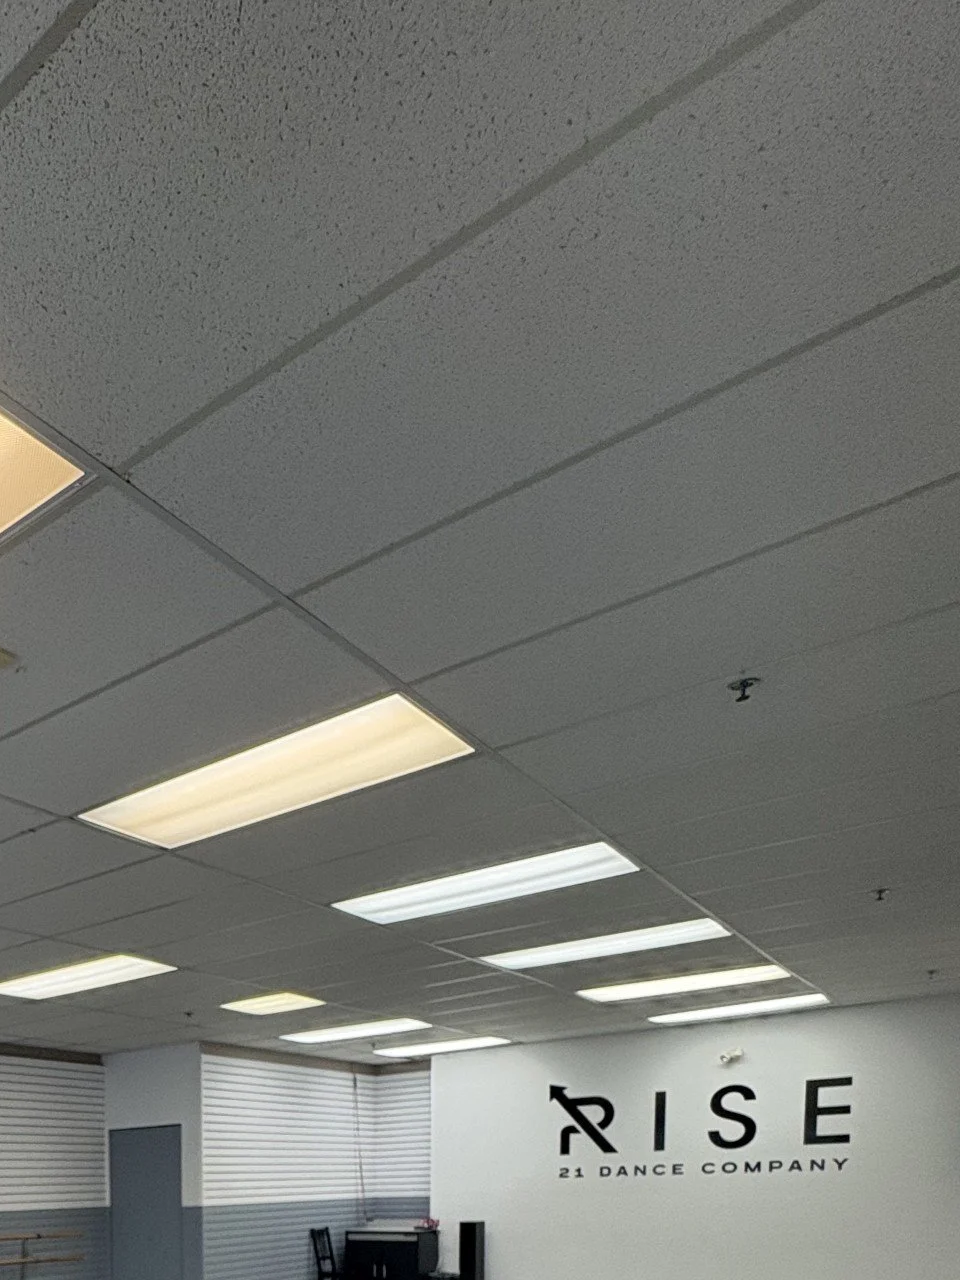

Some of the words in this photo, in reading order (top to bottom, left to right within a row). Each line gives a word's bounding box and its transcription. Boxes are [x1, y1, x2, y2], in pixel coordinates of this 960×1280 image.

[549, 1076, 853, 1155] RISE
[558, 1166, 585, 1179] 21
[599, 1163, 685, 1178] DANCE
[701, 1158, 849, 1175] COMPANY
